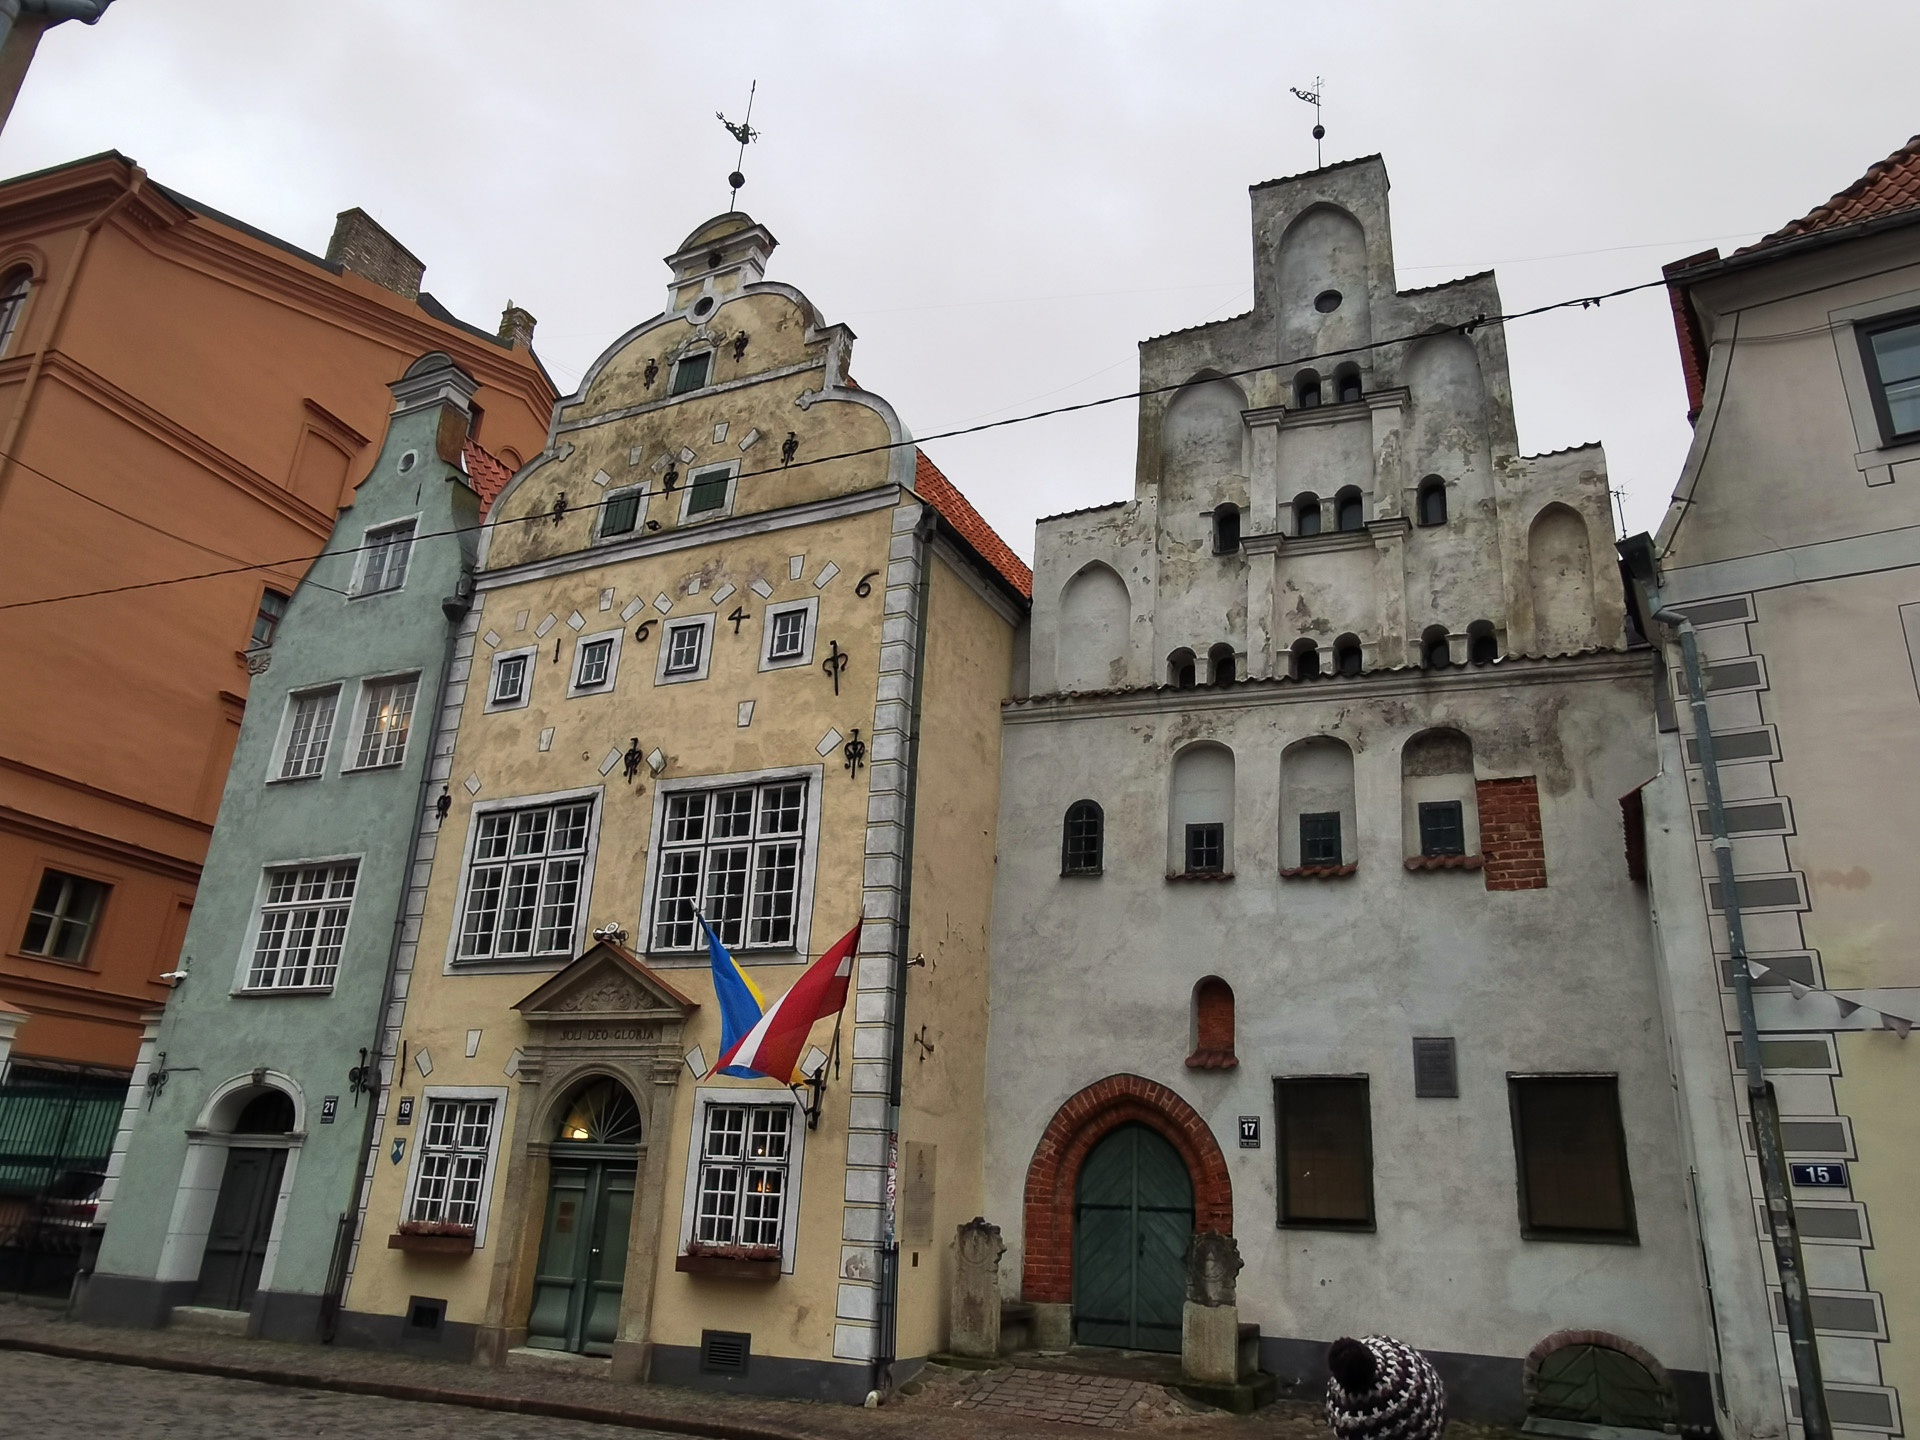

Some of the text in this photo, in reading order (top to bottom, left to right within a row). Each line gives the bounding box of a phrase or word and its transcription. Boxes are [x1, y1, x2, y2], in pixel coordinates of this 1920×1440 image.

[587, 1029, 609, 1041] DEO
[614, 1029, 654, 1040] GLORIA
[323, 1101, 335, 1113] 21
[401, 1102, 411, 1114] 19
[1242, 1122, 1256, 1136] 17
[1805, 1166, 1830, 1183] 15
